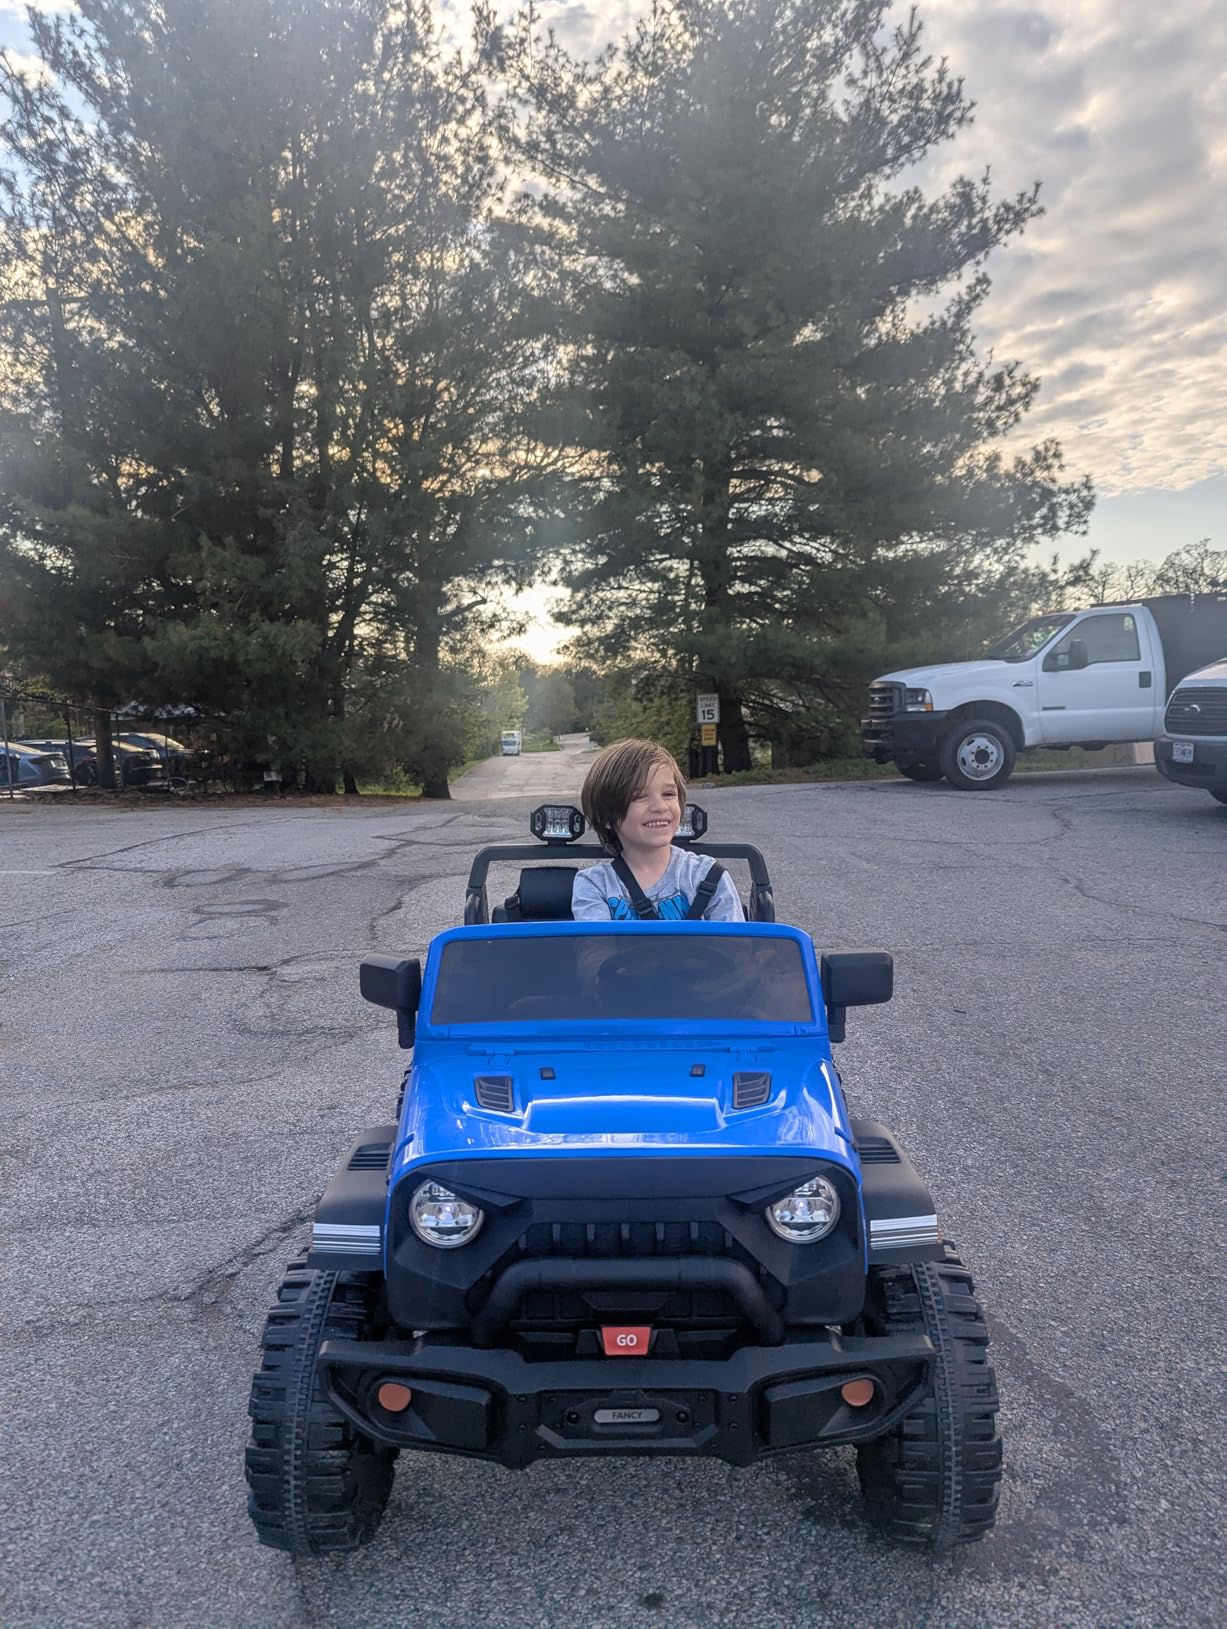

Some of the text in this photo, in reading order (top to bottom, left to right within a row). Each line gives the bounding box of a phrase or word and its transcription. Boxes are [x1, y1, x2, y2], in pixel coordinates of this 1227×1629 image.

[702, 709, 715, 720] 15
[616, 1334, 637, 1346] GO
[612, 1411, 642, 1419] FANCY
